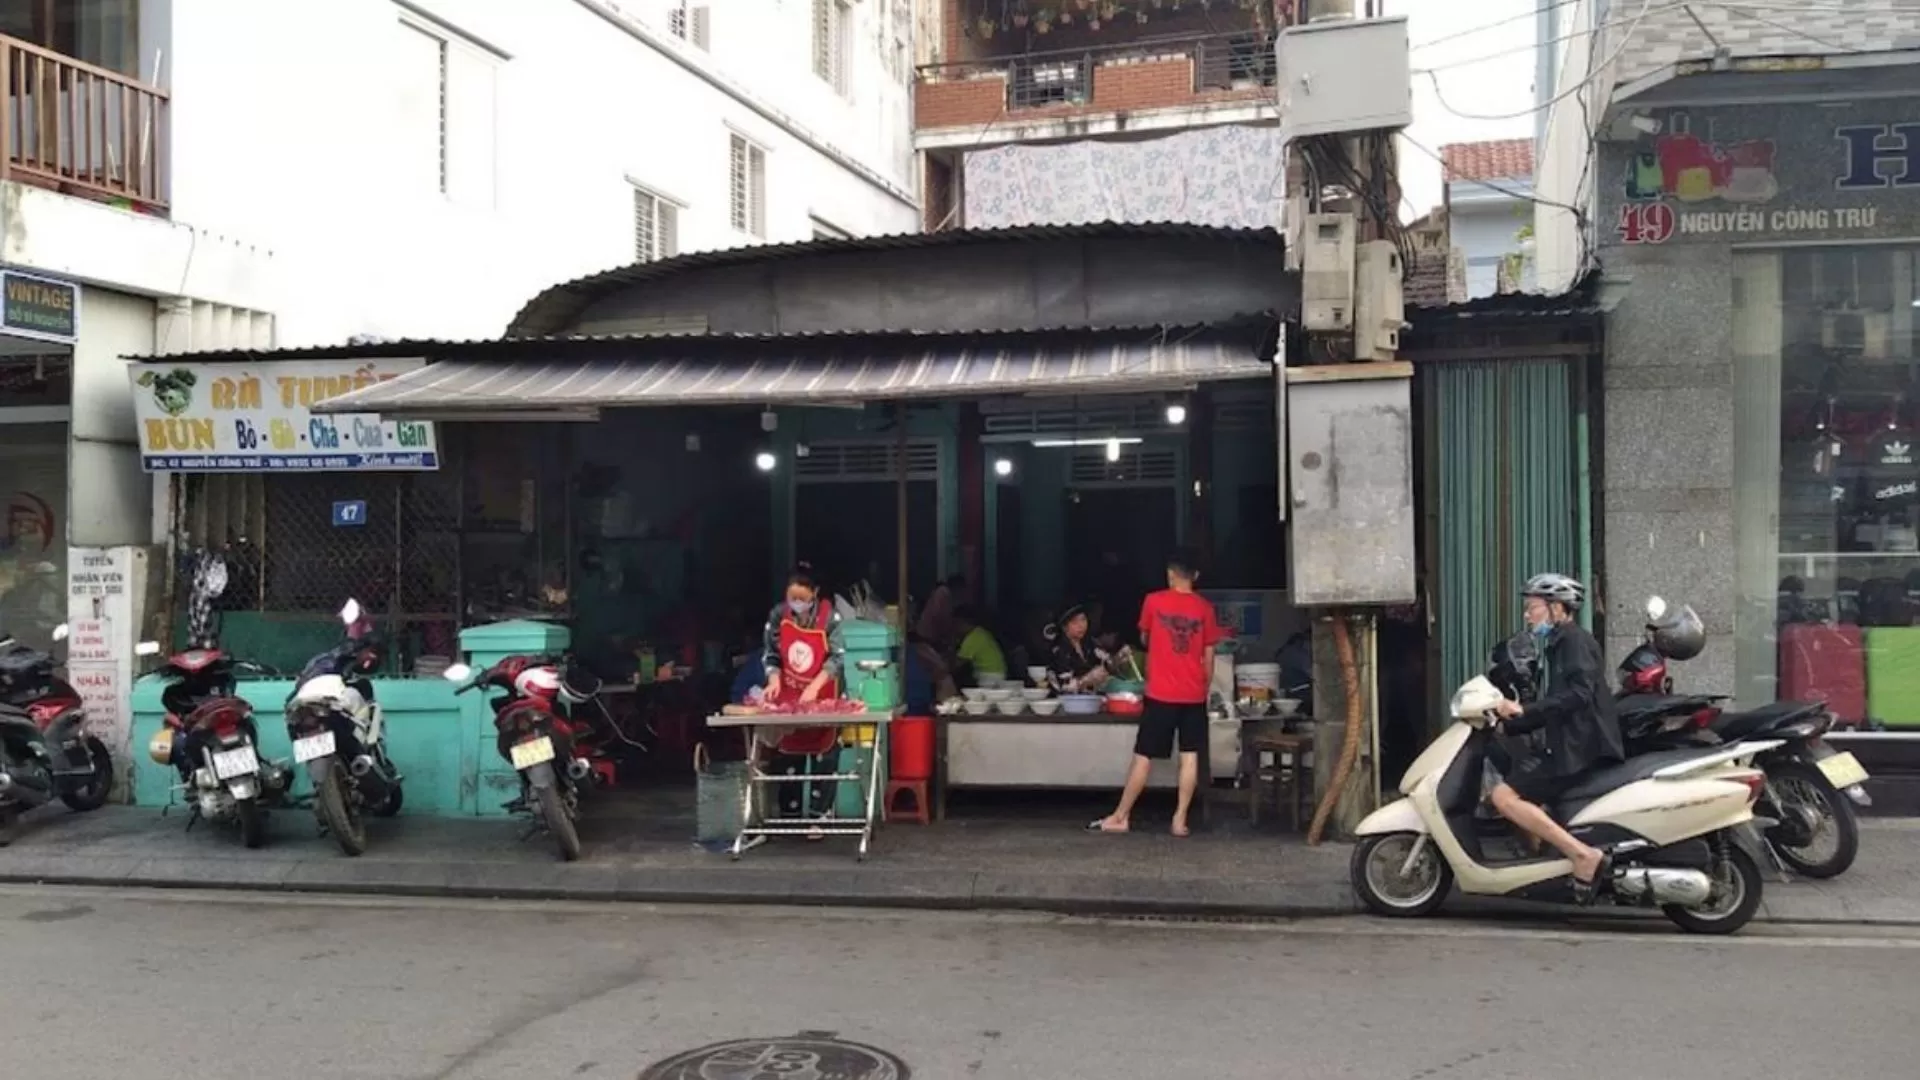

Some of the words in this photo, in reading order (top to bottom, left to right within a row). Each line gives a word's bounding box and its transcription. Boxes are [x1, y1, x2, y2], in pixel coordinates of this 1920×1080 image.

[1614, 203, 1675, 243] 49
[1770, 204, 1829, 231] CÔNG
[8, 283, 72, 310] VINTAGE
[235, 418, 258, 449] Bò
[353, 416, 383, 448] Cua
[340, 504, 358, 521] 47
